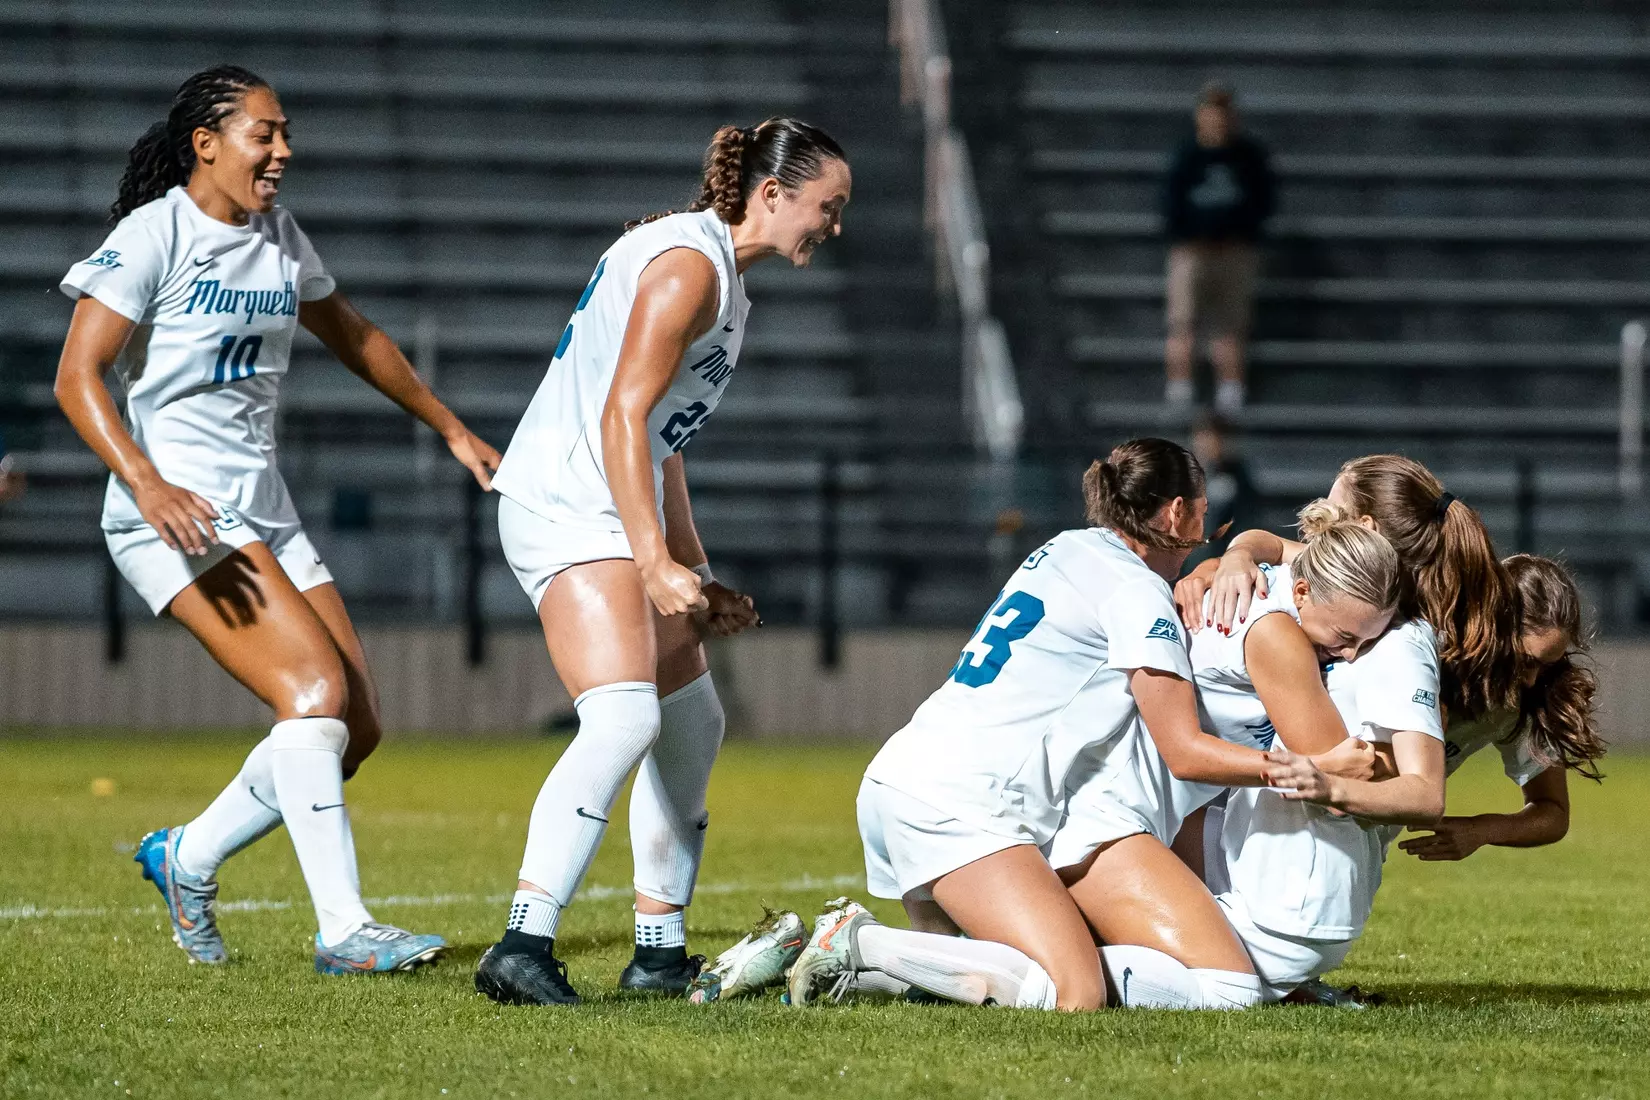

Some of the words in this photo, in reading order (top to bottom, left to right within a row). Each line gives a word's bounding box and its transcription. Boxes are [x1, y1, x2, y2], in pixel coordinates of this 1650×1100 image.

[185, 279, 298, 324] Marquett
[212, 335, 263, 384] 10
[1148, 626, 1179, 641] EAS
